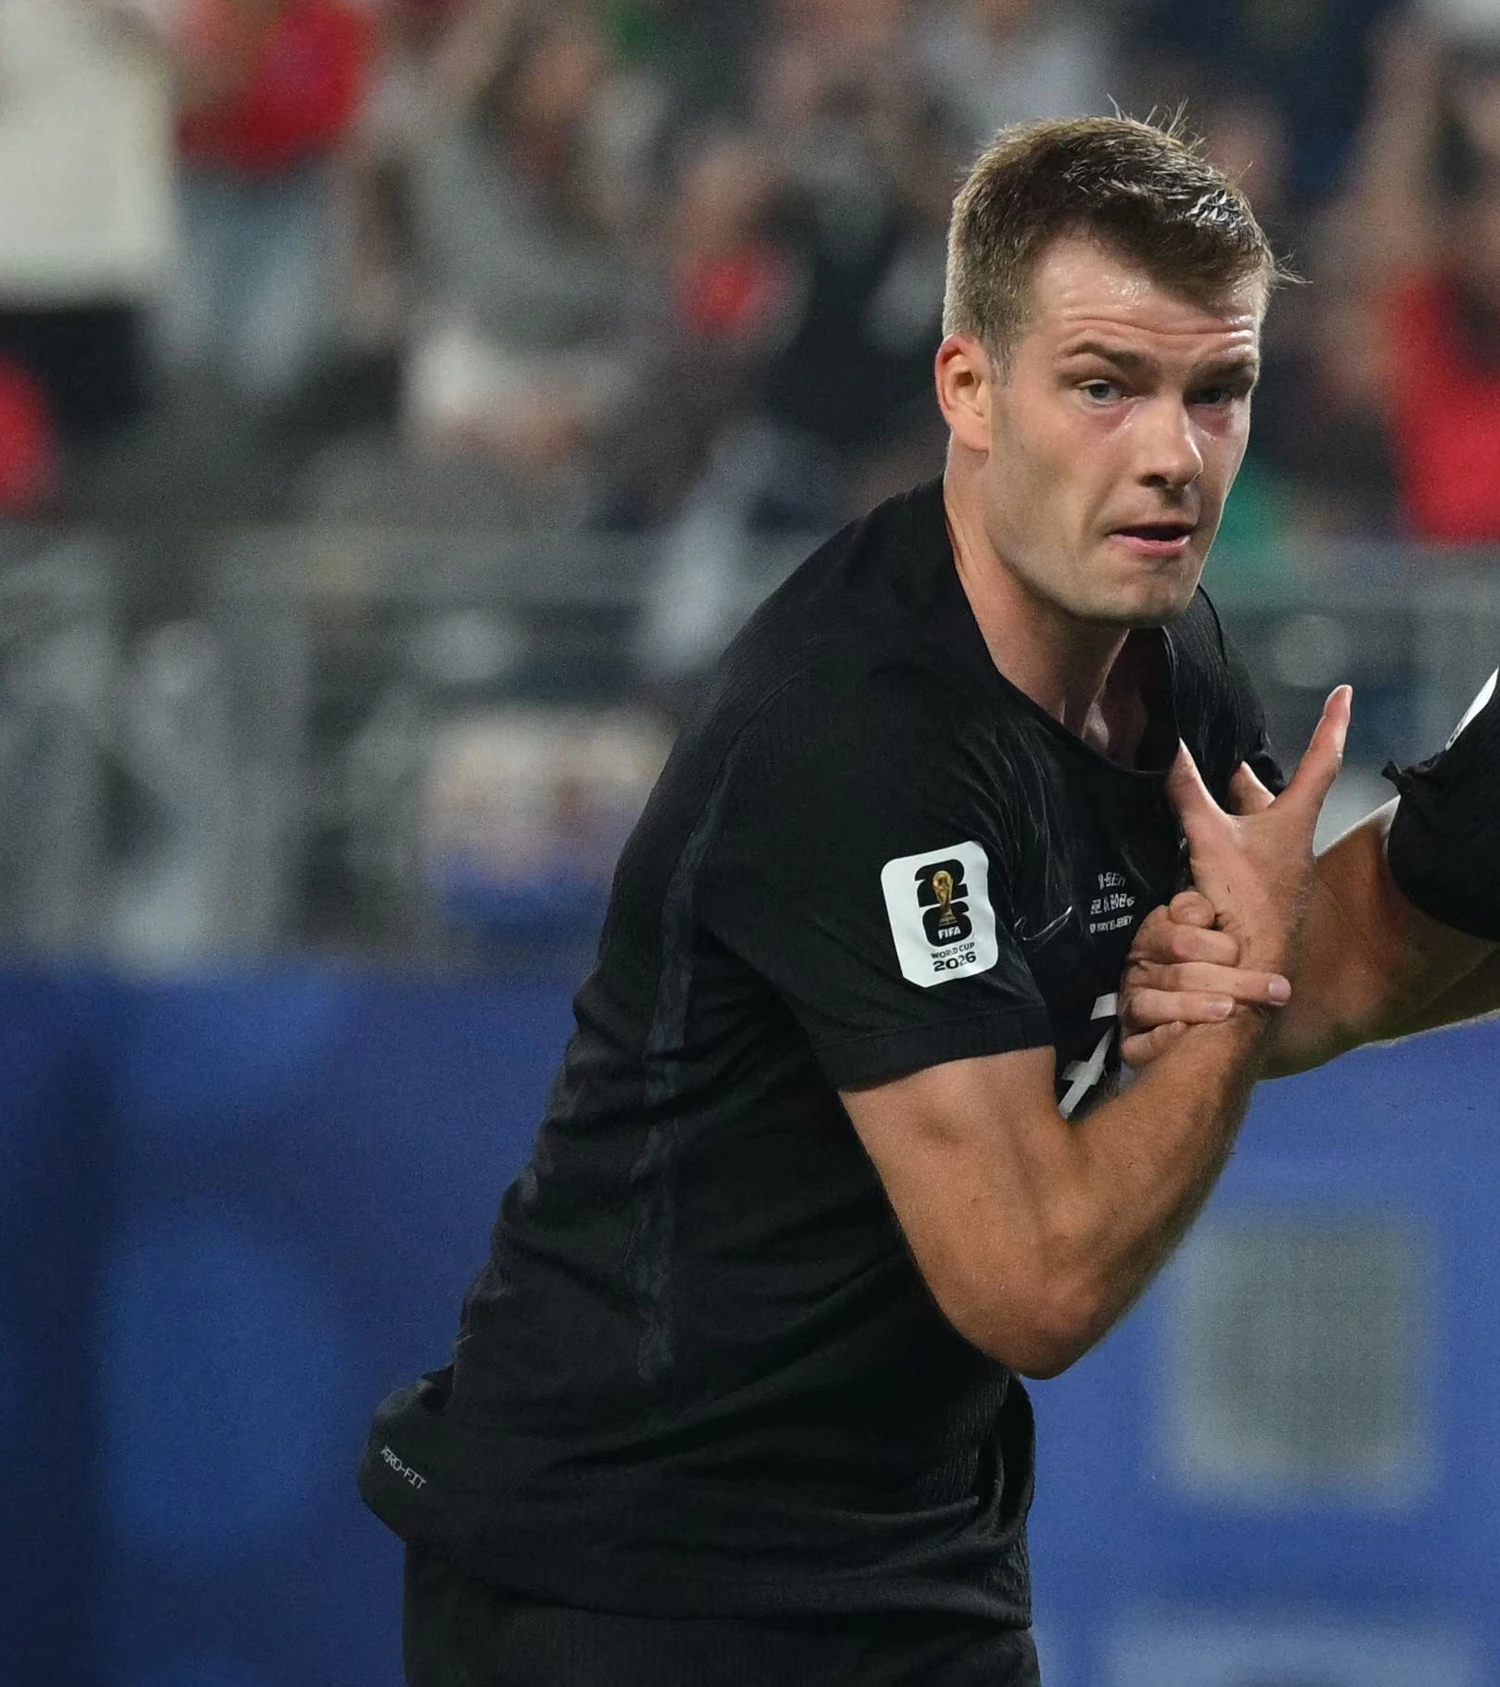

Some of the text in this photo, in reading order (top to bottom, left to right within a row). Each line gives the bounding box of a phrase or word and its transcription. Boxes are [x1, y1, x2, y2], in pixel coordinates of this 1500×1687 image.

[937, 925, 962, 940] FIFA
[930, 941, 976, 960] WORLD CUP
[933, 951, 977, 972] 2026
